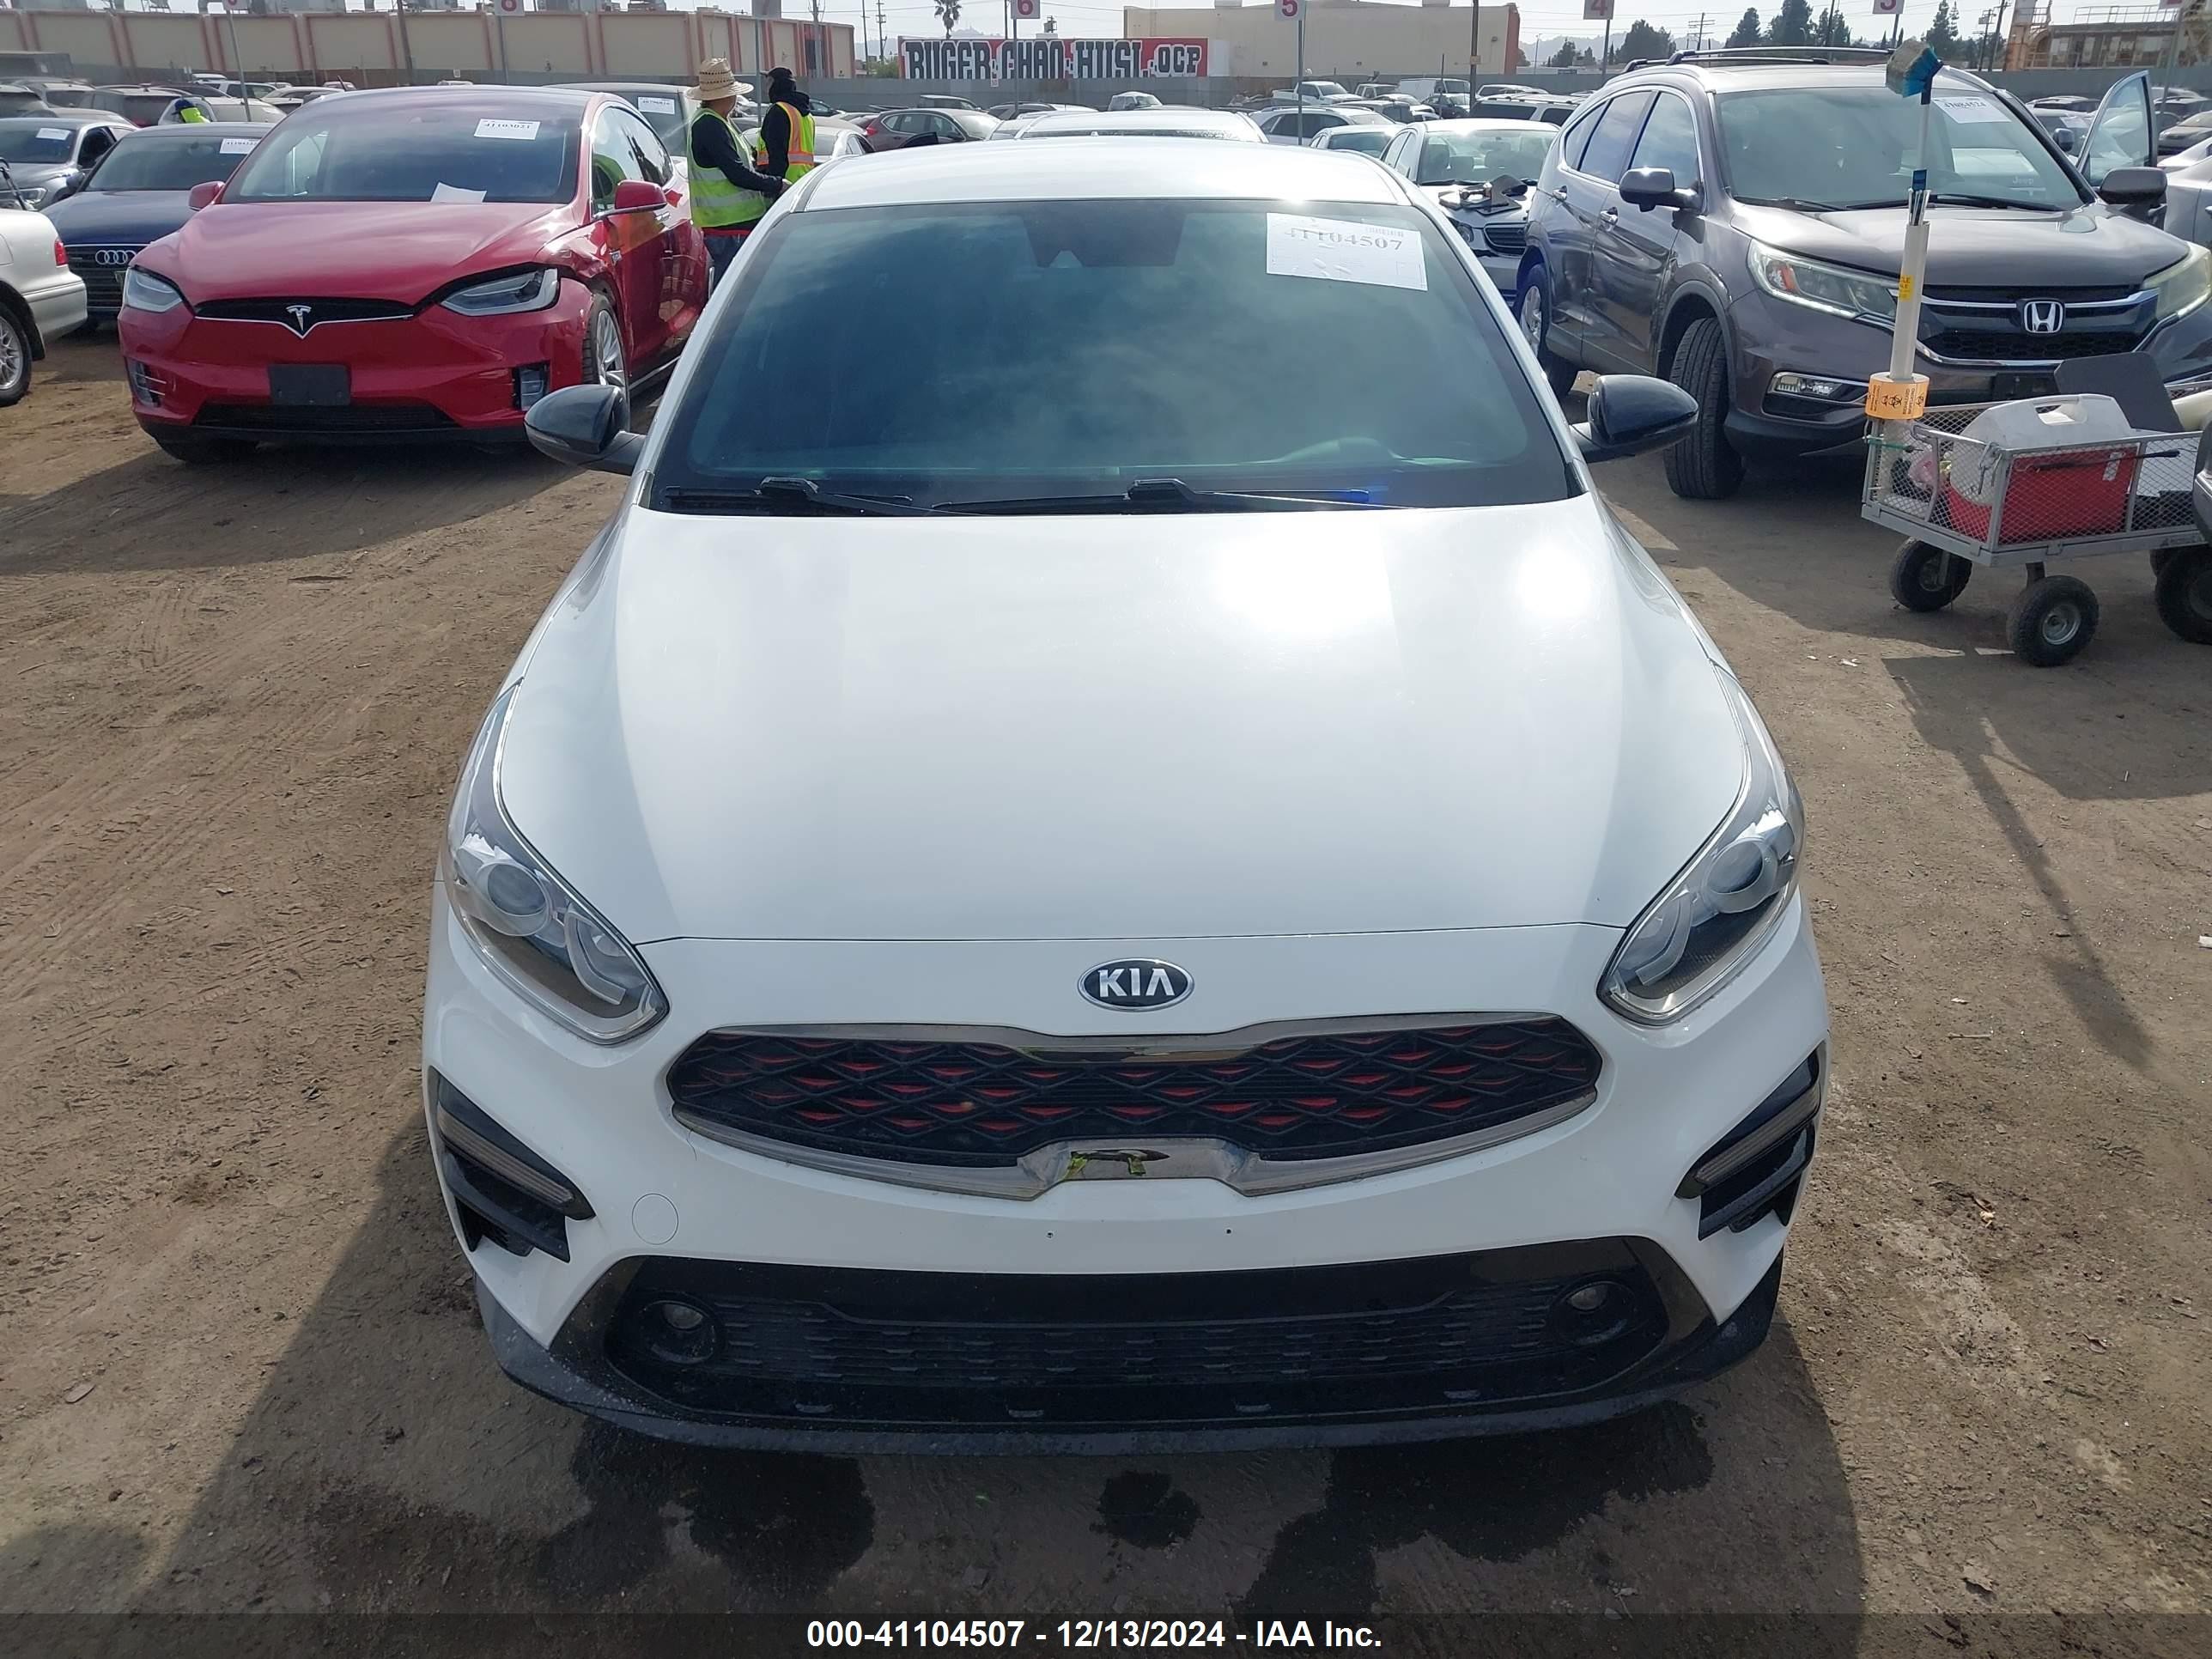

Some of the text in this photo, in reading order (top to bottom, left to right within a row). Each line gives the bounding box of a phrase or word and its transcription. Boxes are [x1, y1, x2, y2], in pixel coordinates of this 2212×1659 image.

[1282, 0, 1298, 17] 5
[1285, 227, 1403, 251] 41104507
[1097, 968, 1176, 998] KIA
